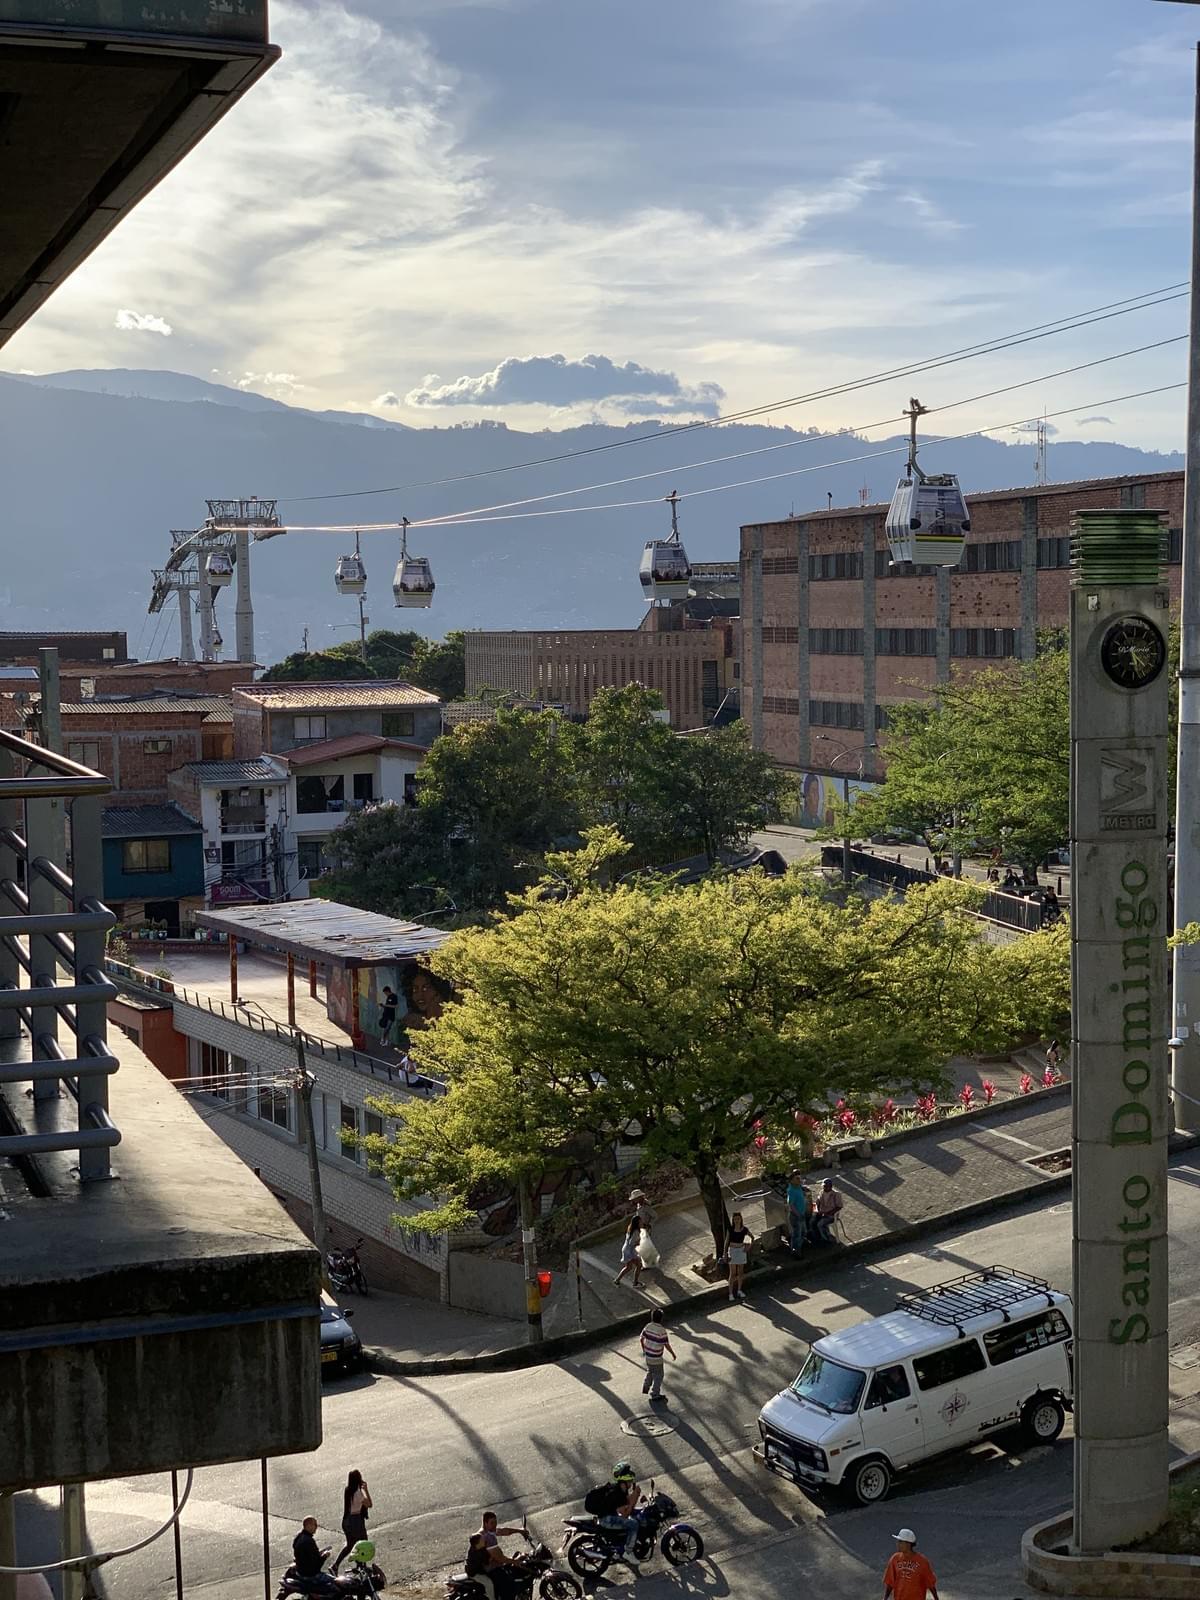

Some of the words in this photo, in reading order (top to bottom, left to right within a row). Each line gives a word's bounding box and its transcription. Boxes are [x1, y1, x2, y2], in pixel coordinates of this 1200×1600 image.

[1105, 814, 1155, 830] METRO
[1109, 861, 1158, 1147] Domingo
[1108, 1175, 1150, 1344] Santo
